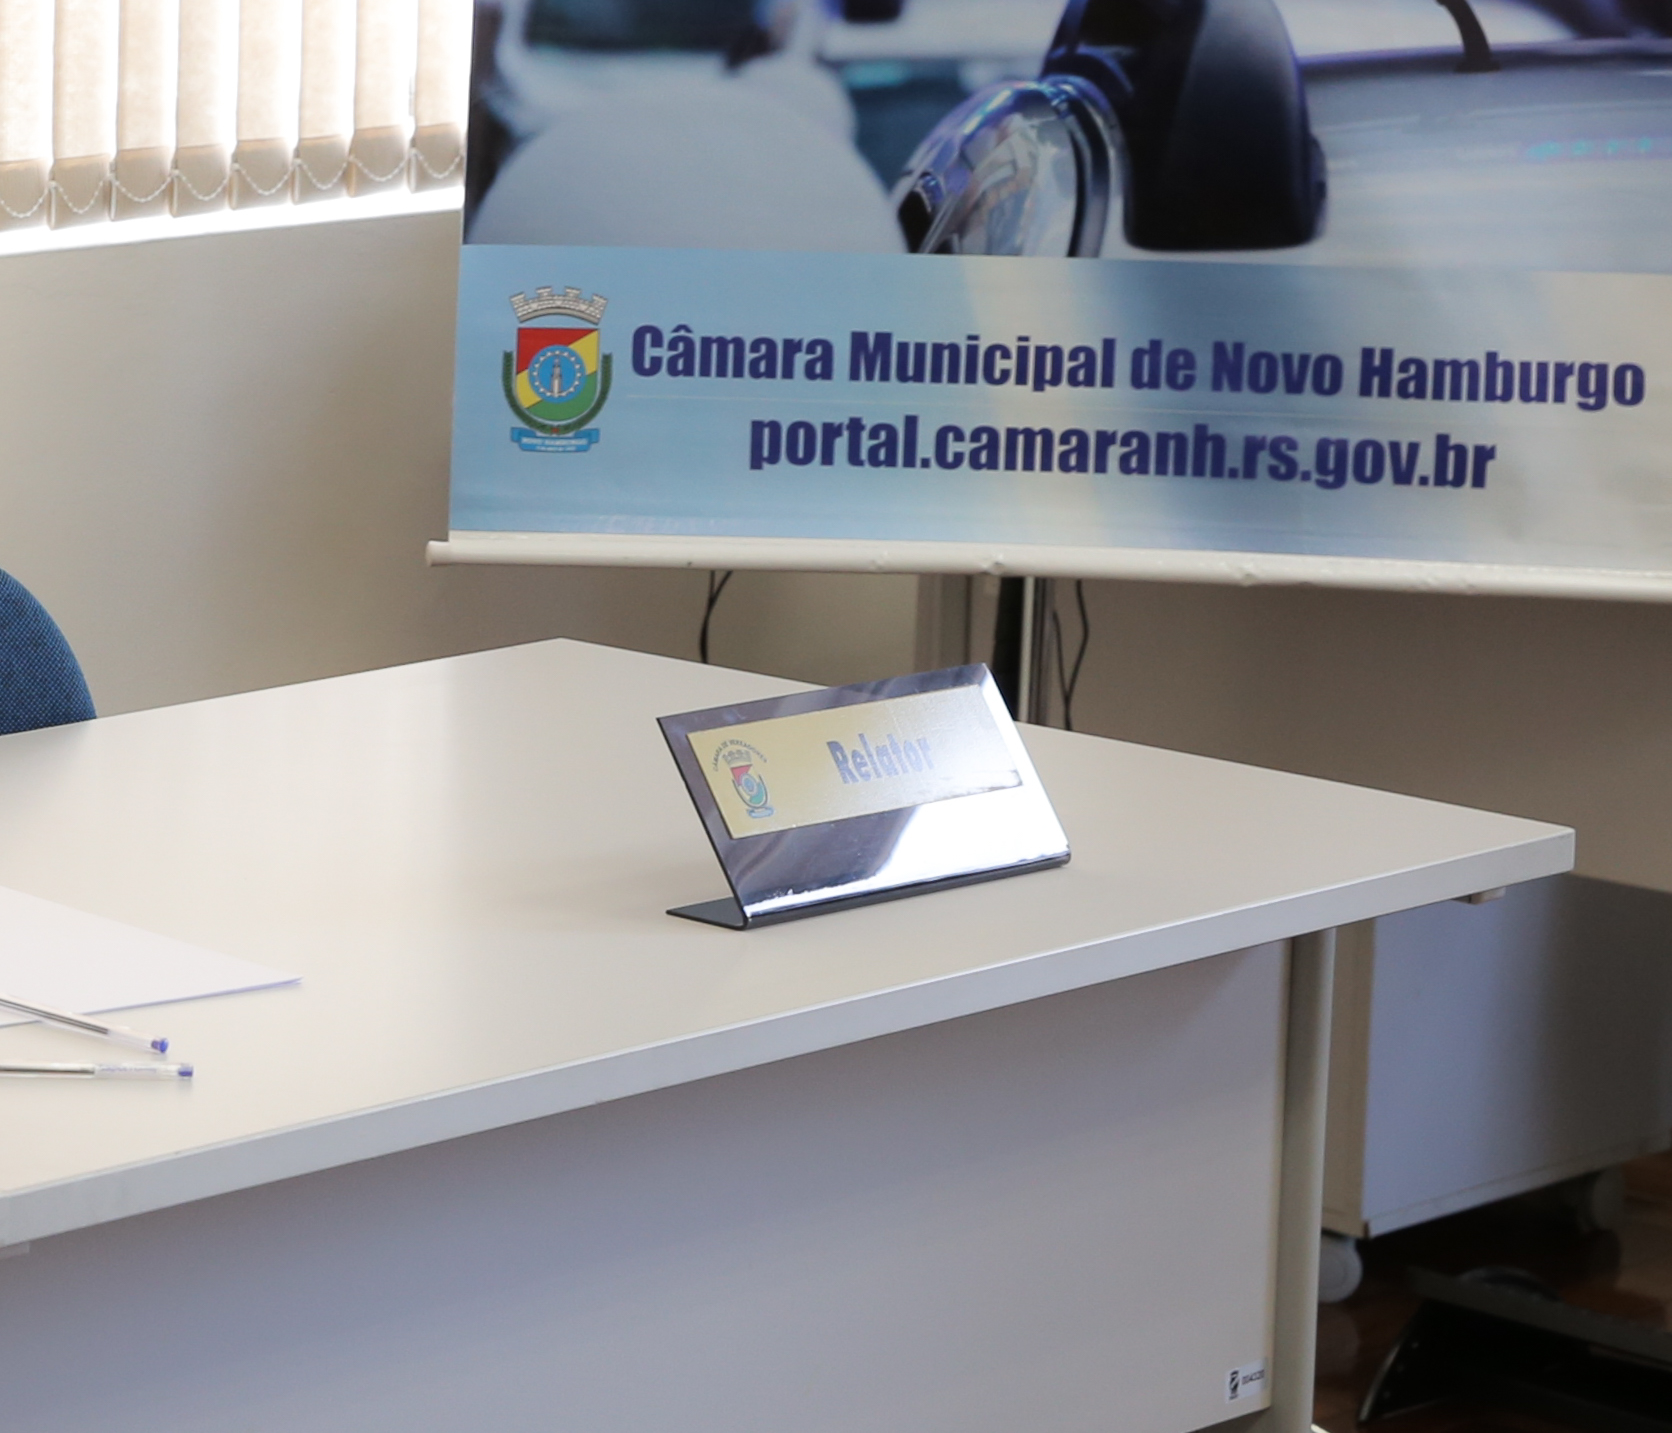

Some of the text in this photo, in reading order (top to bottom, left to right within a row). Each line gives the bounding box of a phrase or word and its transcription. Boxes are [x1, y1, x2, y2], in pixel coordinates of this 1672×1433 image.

[631, 323, 1646, 413] Câmara Municipal de Novo Hamburgo
[748, 409, 1496, 491] portal.camaranh.rs.gov.br
[826, 733, 935, 785] Relator
